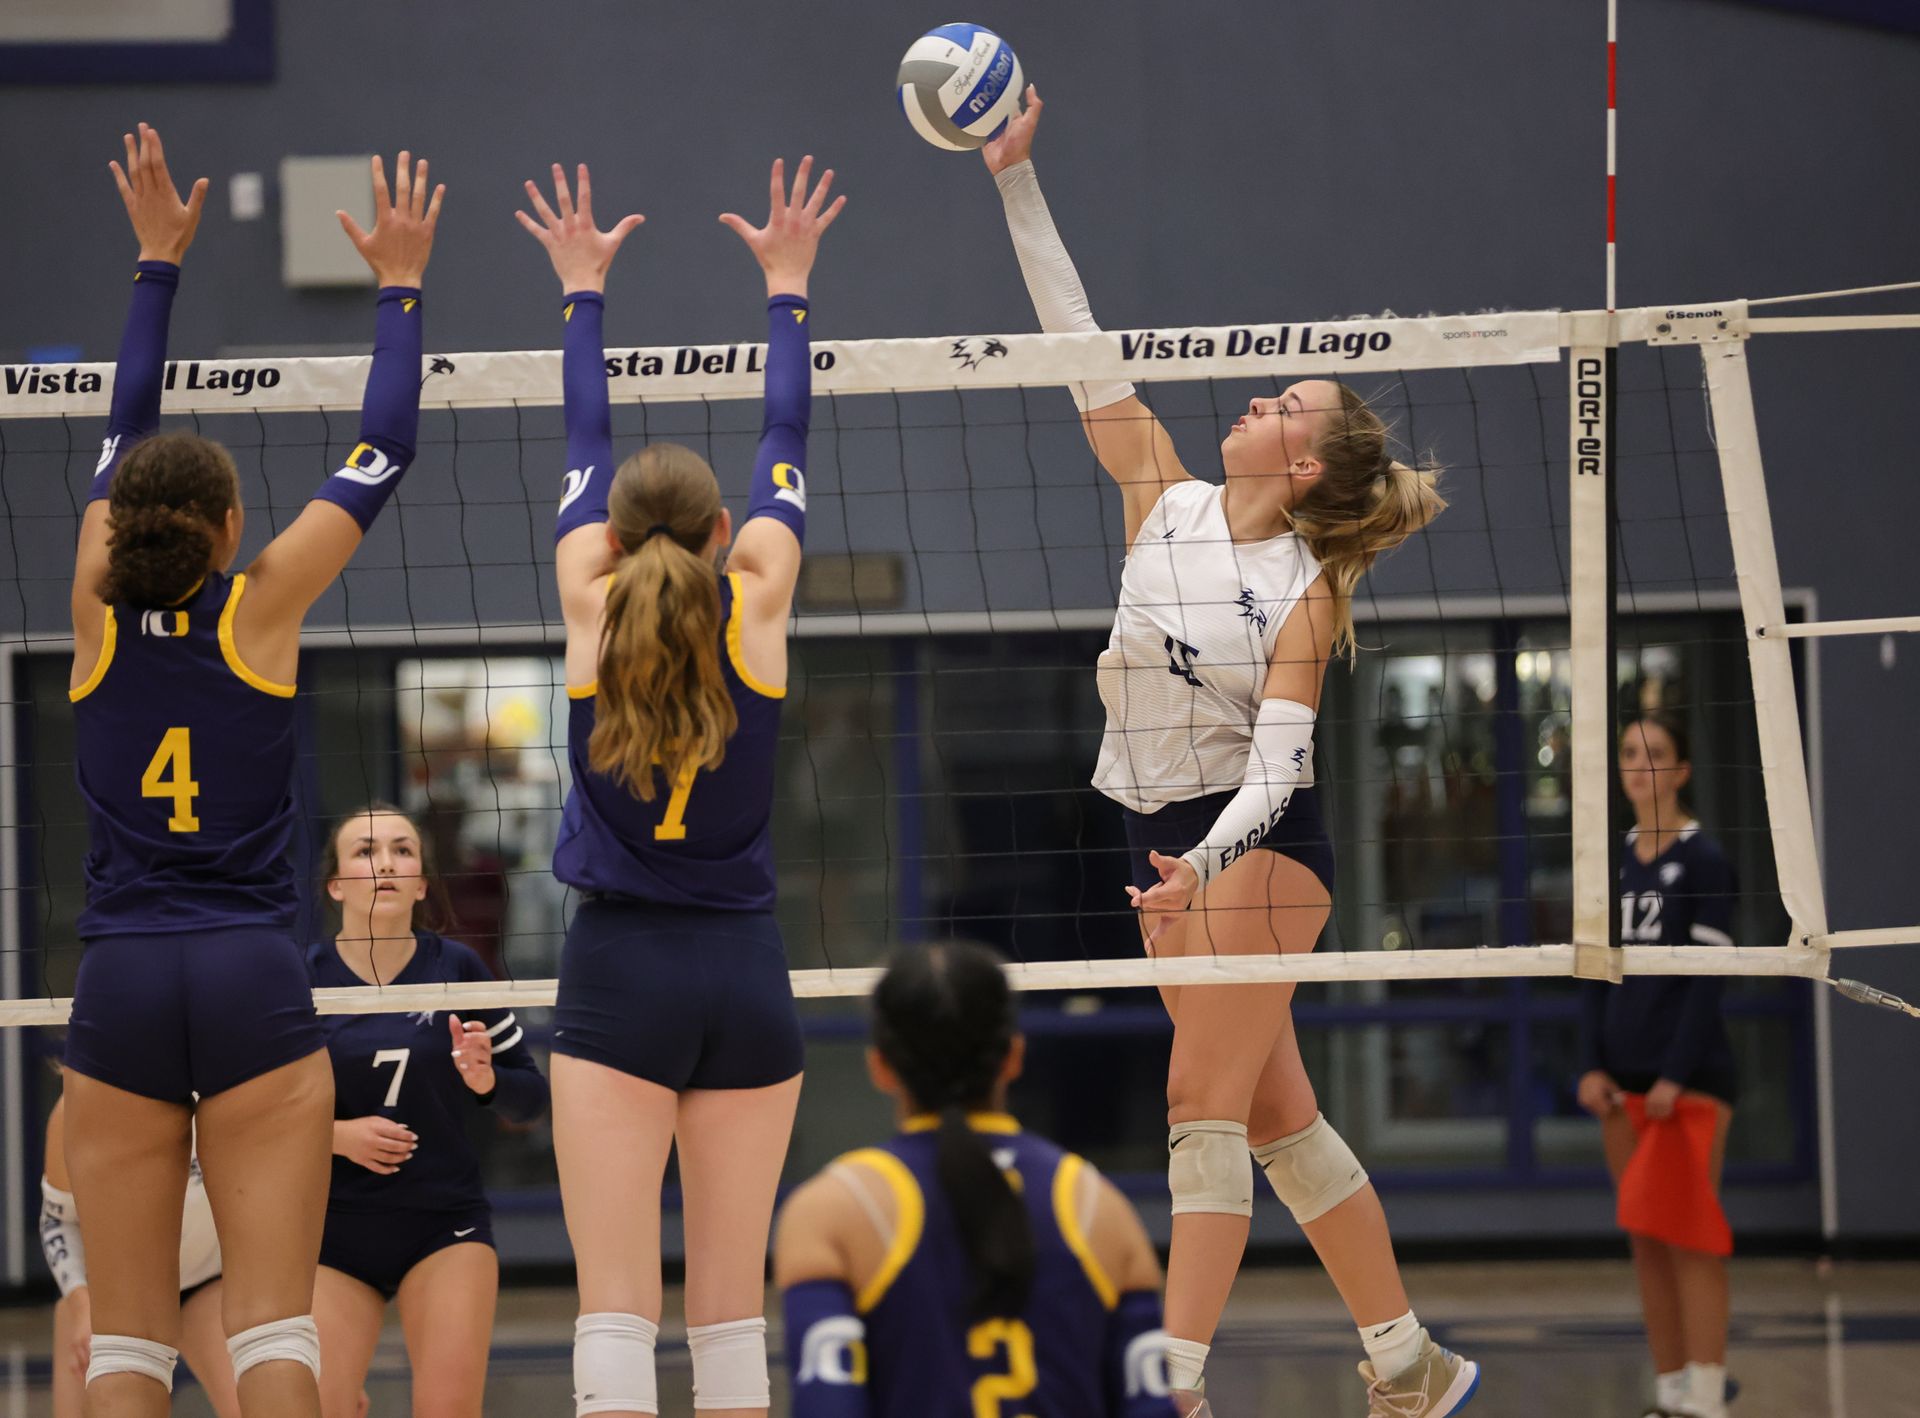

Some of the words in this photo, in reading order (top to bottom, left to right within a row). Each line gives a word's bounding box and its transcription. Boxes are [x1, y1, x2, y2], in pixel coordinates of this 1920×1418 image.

[969, 51, 1012, 113] molten
[1120, 331, 1215, 361] Vista
[1226, 325, 1289, 357] Del
[1299, 326, 1392, 360] Lago
[1676, 309, 1723, 319] Senoh
[5, 366, 102, 395] Vista
[186, 362, 281, 396] Lago
[604, 351, 663, 377] sta
[673, 345, 737, 375] Del
[1577, 358, 1602, 476] PORTER
[141, 727, 199, 832] 4
[650, 735, 706, 841] 7
[1620, 890, 1664, 942] 12
[372, 1048, 410, 1107] 7
[967, 1316, 1039, 1418] 2
